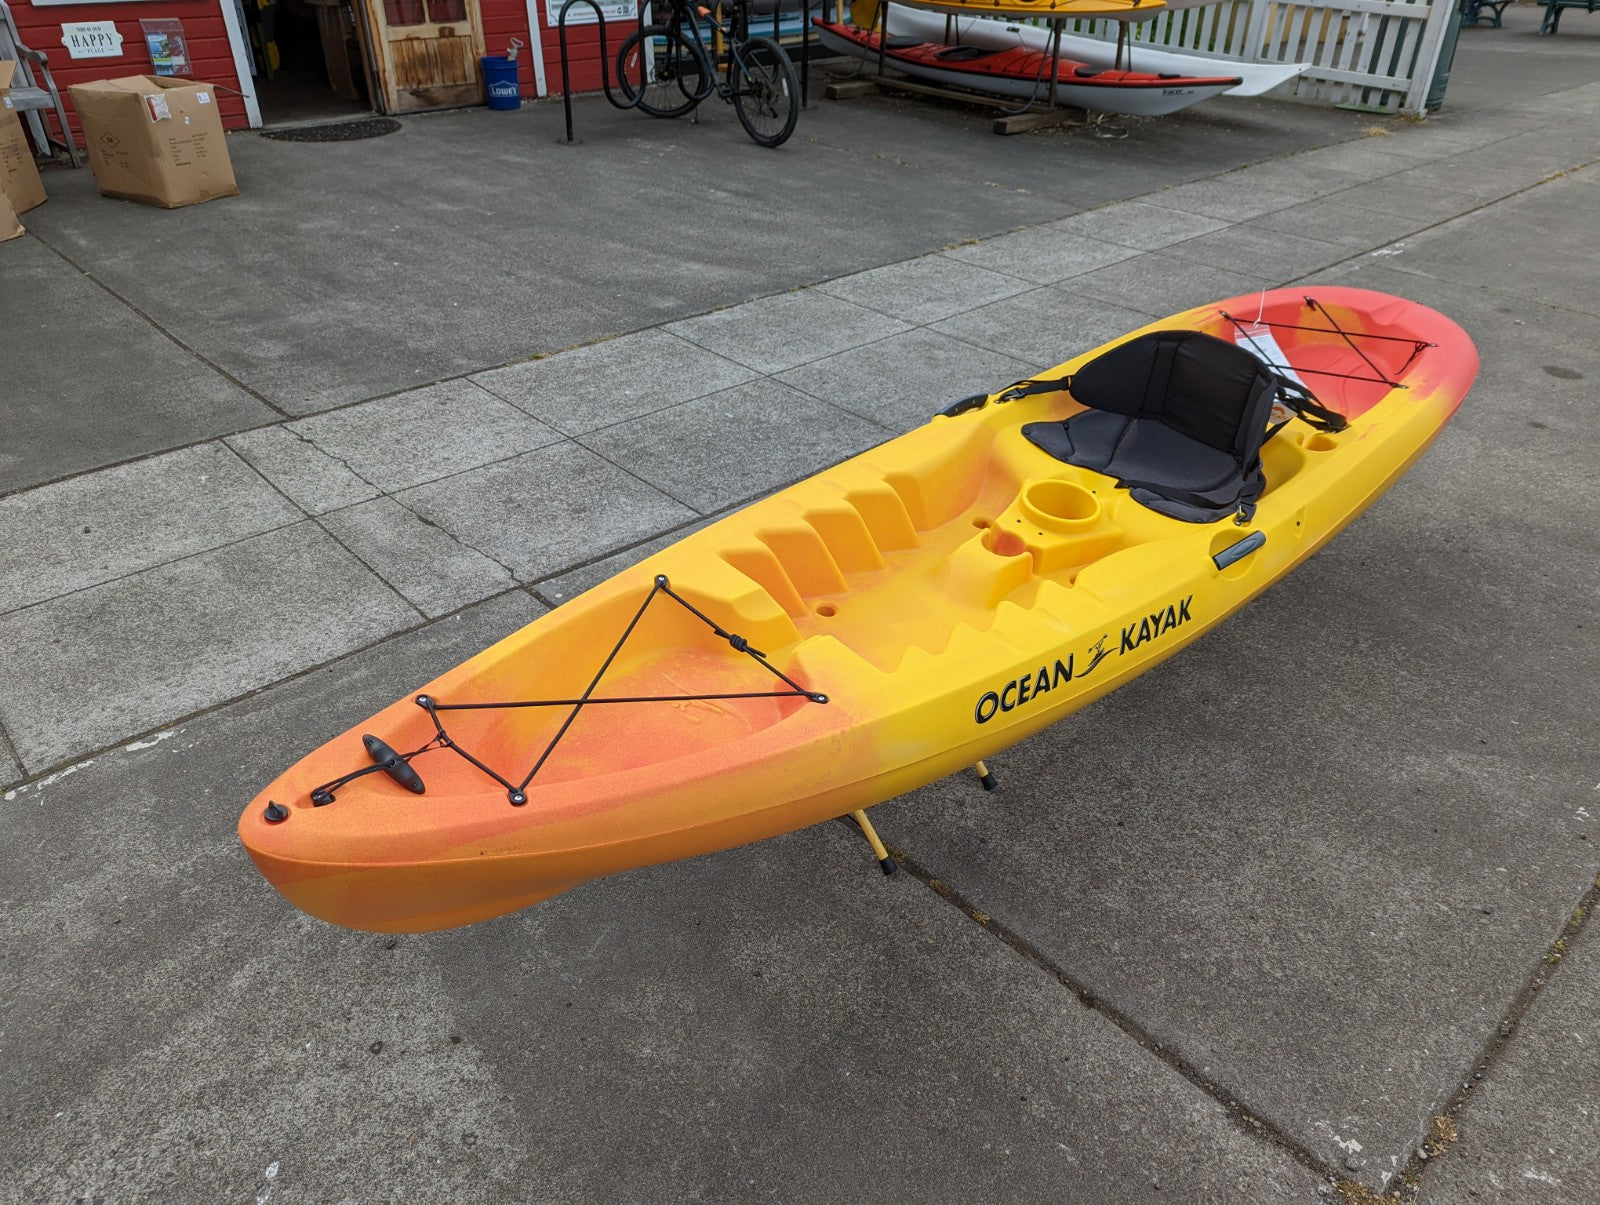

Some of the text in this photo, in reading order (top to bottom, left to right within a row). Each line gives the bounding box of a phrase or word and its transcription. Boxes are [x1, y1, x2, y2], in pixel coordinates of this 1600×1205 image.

[70, 33, 113, 47] HAPPY
[491, 86, 517, 95] LOWE'S
[974, 594, 1194, 724] OCEAN KAYAK
